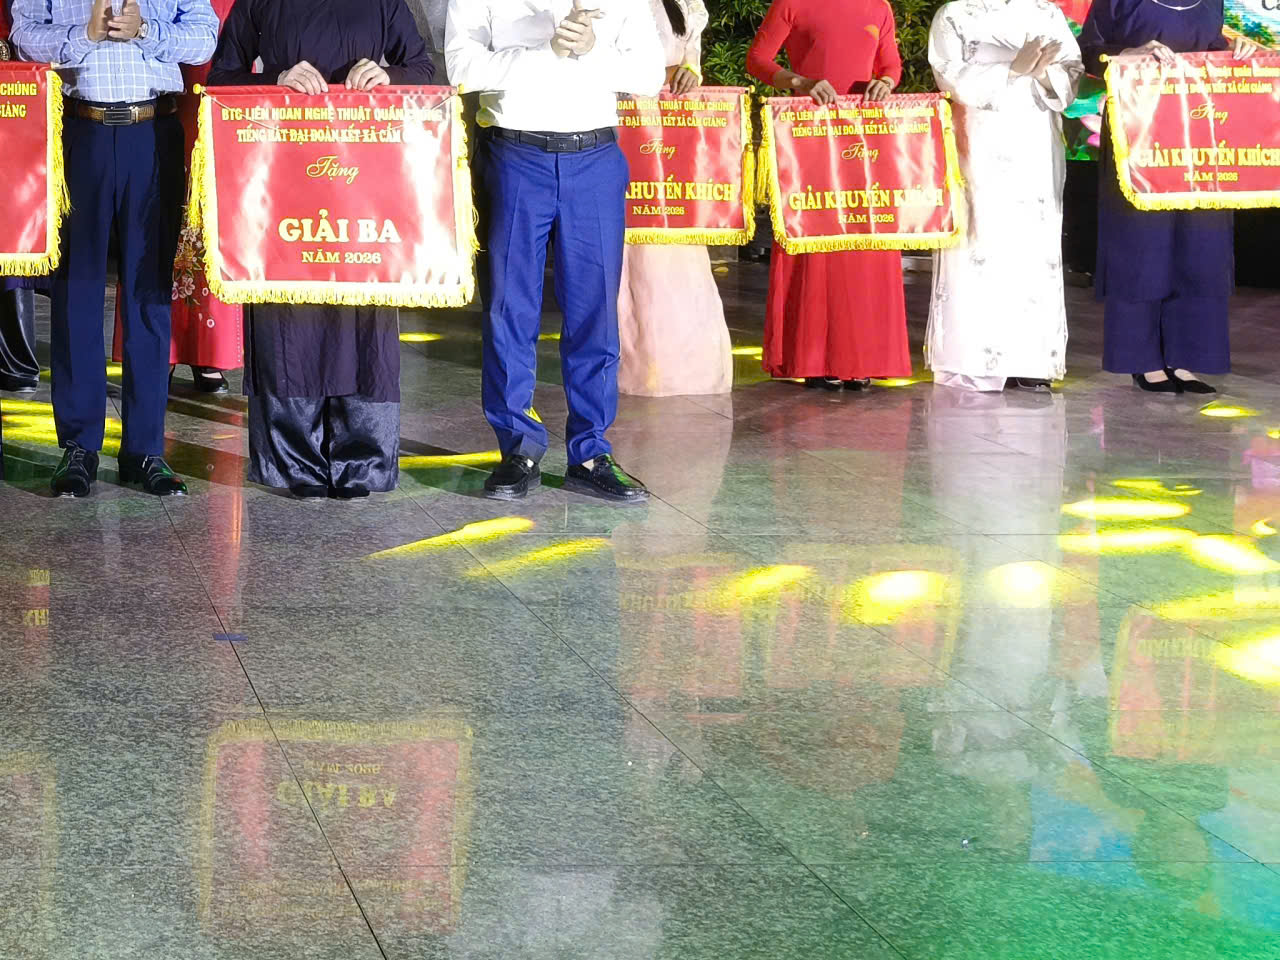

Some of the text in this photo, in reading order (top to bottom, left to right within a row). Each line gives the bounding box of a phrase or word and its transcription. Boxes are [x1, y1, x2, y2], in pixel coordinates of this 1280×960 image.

[0, 79, 37, 96] CHÚNG
[222, 108, 243, 121] BTC
[246, 105, 269, 121] LIÊN
[272, 108, 302, 121] HOAN
[337, 106, 372, 123] THUẬT
[617, 101, 635, 110] OAN
[626, 117, 640, 128] ĐẠI
[663, 113, 676, 127] KẾT
[237, 123, 266, 143] TIẾNG
[1172, 140, 1235, 166] KUYẾN
[306, 155, 360, 184] Tặng
[685, 178, 736, 201] KHÍCH
[789, 185, 822, 211] GIẢI
[825, 182, 892, 209] KHUYẾN
[633, 204, 661, 215] NĂM
[278, 209, 402, 243] GIẢI BA
[302, 248, 382, 264] NĂM 2026
